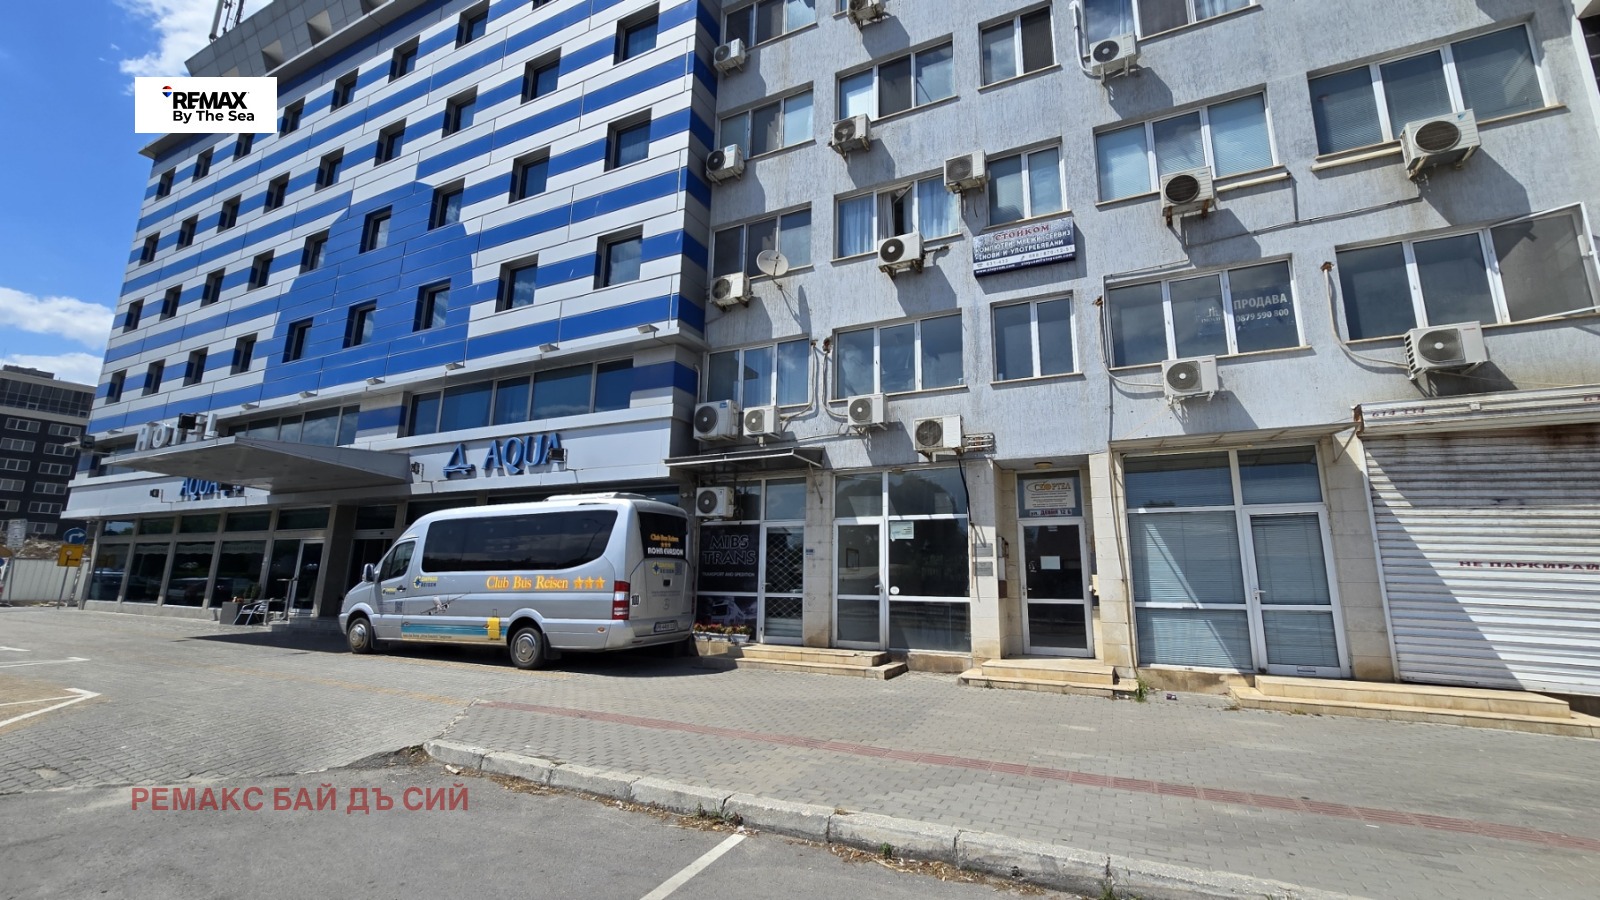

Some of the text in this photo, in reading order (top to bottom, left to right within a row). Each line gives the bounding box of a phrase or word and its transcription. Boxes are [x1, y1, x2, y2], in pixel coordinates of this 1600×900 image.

[1234, 293, 1288, 309] ПРОДАВА
[1236, 308, 1289, 322] 0879 590 800
[135, 413, 219, 452] HOTEL
[482, 432, 562, 475] AQUA
[709, 534, 749, 550] MIBS
[702, 550, 756, 565] TRANS
[486, 575, 569, 590] Club Bus Reisen
